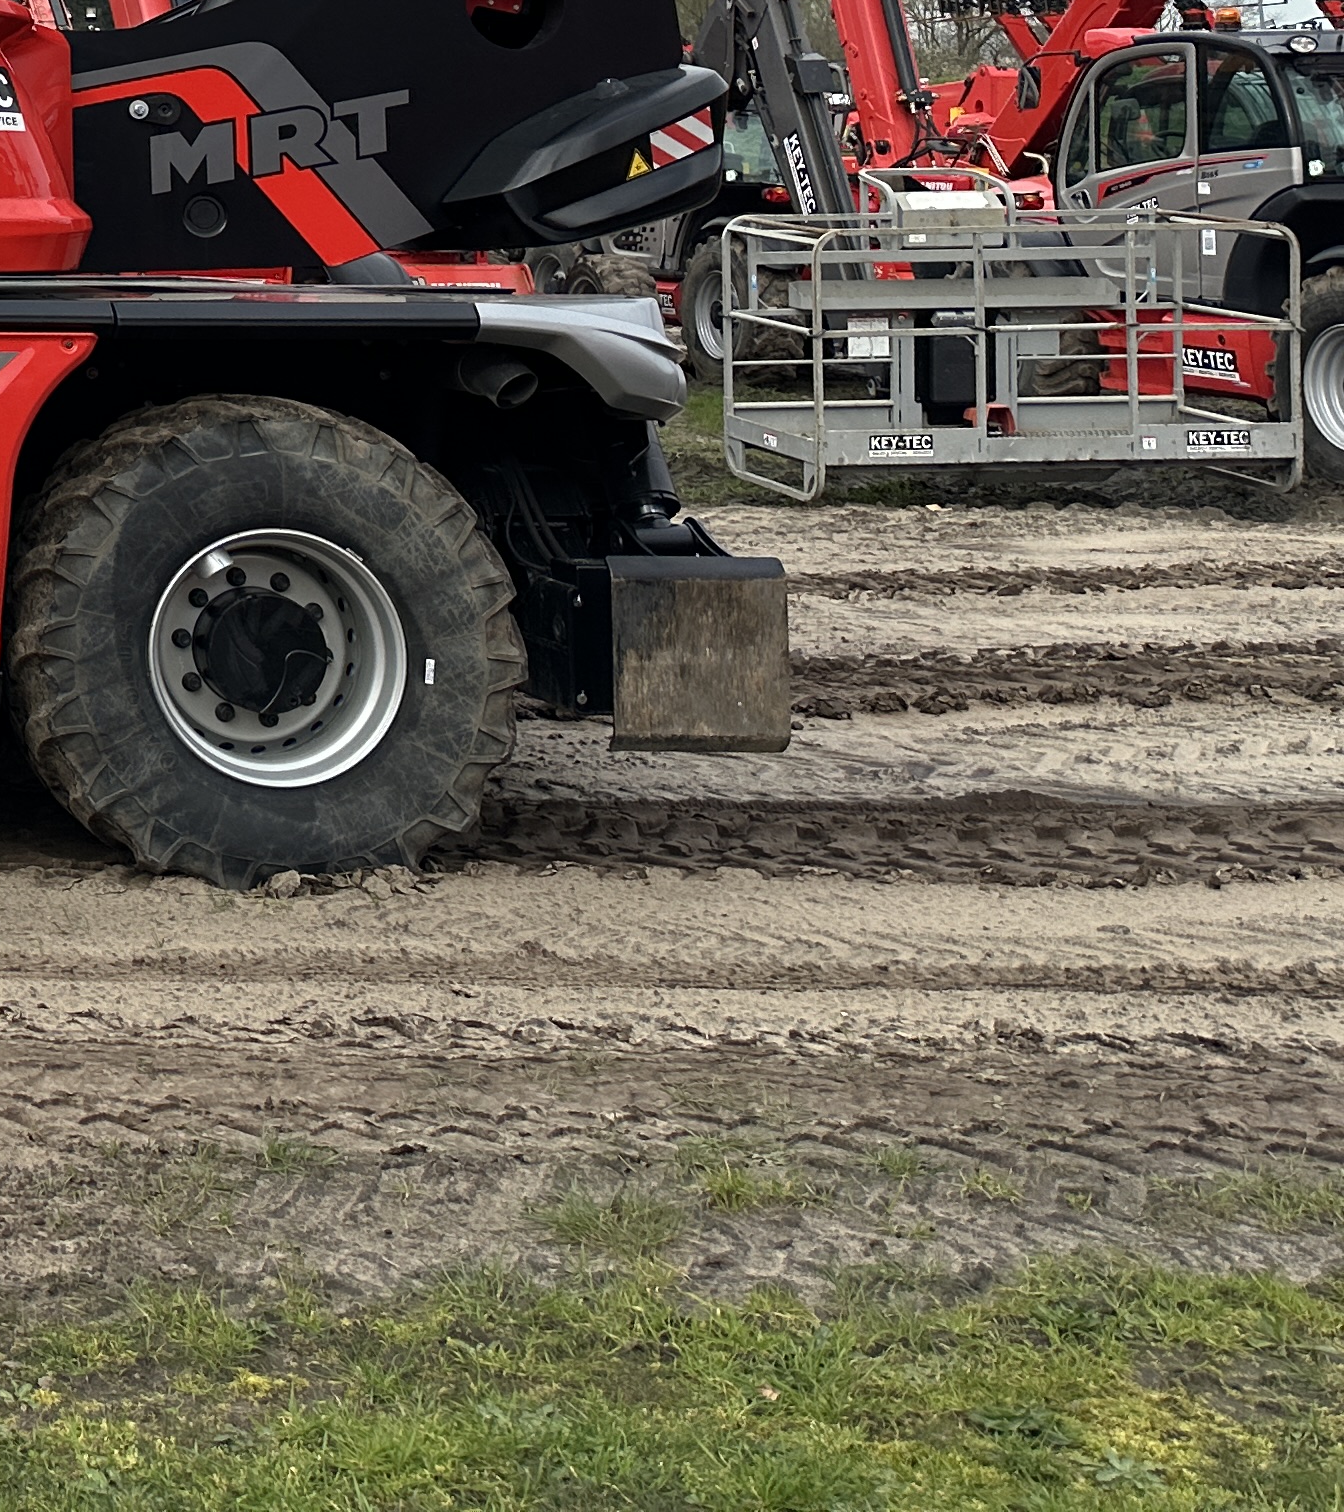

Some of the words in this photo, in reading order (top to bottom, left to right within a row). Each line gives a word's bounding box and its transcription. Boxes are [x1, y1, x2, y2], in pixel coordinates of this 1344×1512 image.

[150, 89, 409, 195] MRT
[788, 133, 817, 214] KEY-TEC
[870, 435, 932, 450] KEY-TEC
[1188, 430, 1249, 445] KEY-TEC
